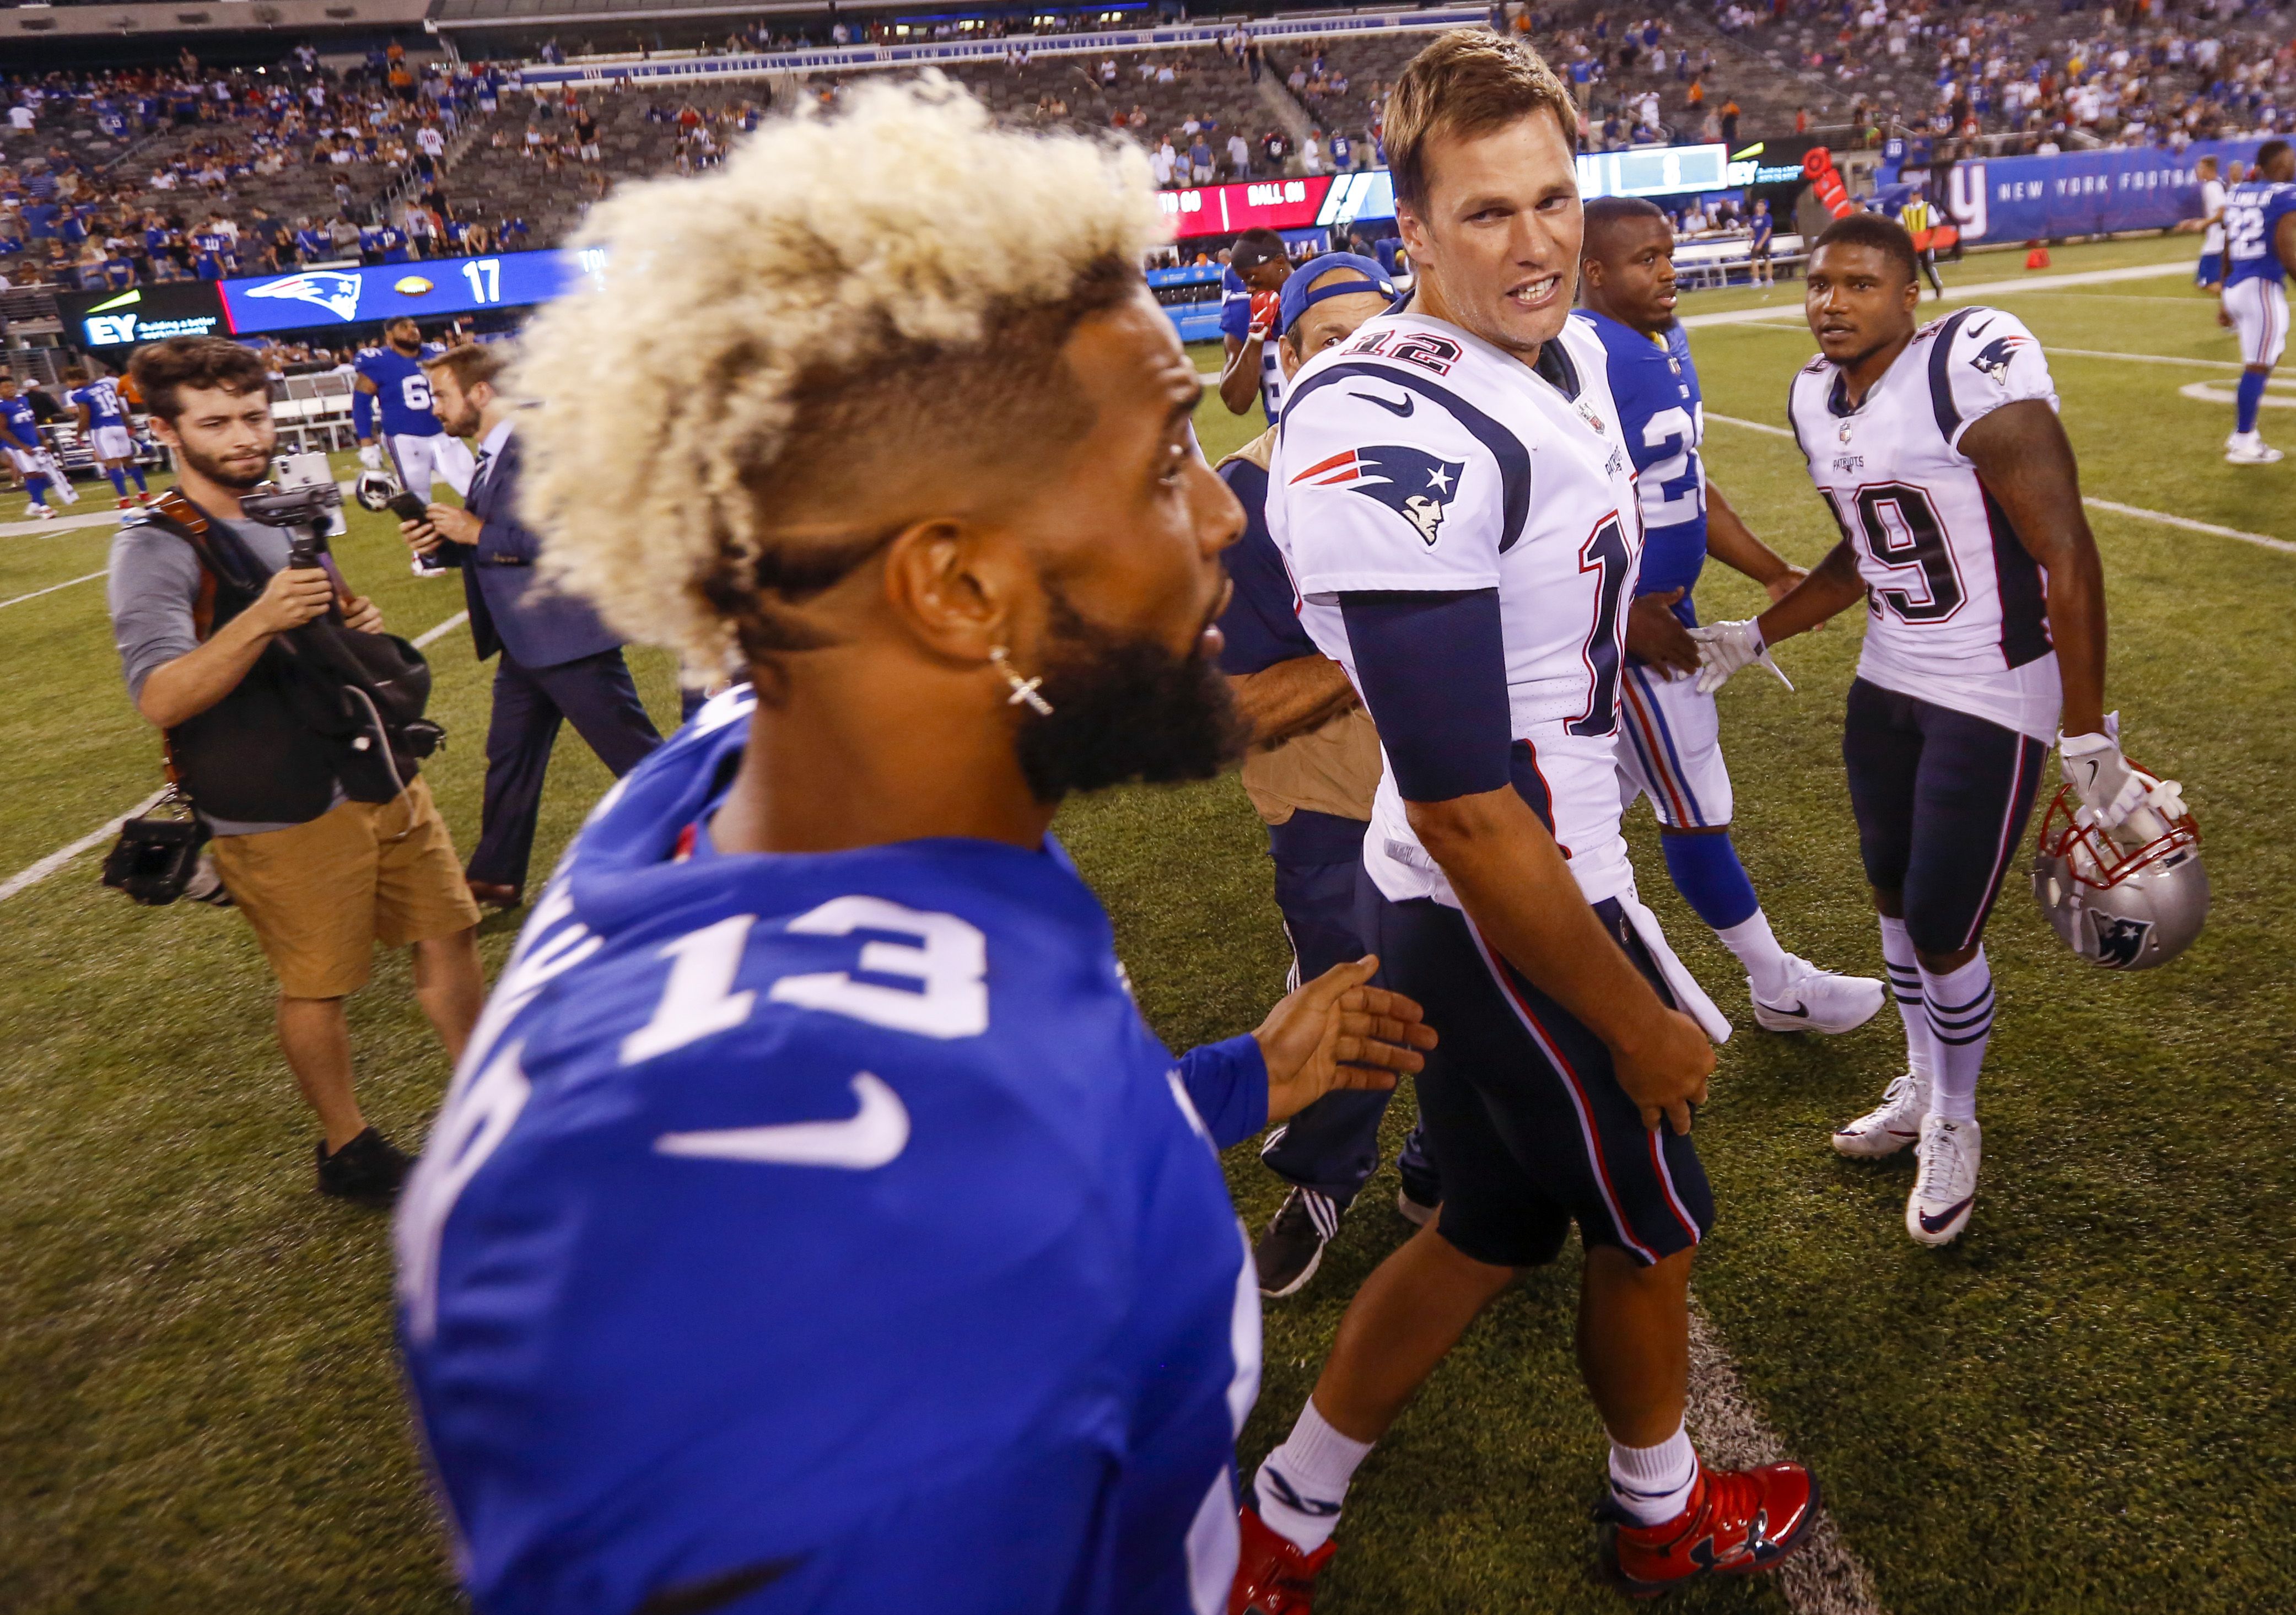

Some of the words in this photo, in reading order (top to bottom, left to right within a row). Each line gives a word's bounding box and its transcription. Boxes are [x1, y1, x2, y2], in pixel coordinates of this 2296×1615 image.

[1728, 160, 1759, 187] EY
[1998, 180, 2044, 202] NEW
[2055, 174, 2108, 197] YORK
[2118, 168, 2198, 191] FOOTBA
[462, 258, 500, 304] 17
[84, 313, 138, 346] EY
[1340, 330, 1464, 376] 12
[402, 374, 438, 411] 6
[1833, 456, 1864, 472] PATRIOTS
[1564, 491, 1642, 737] 1
[618, 894, 990, 1065] 13
